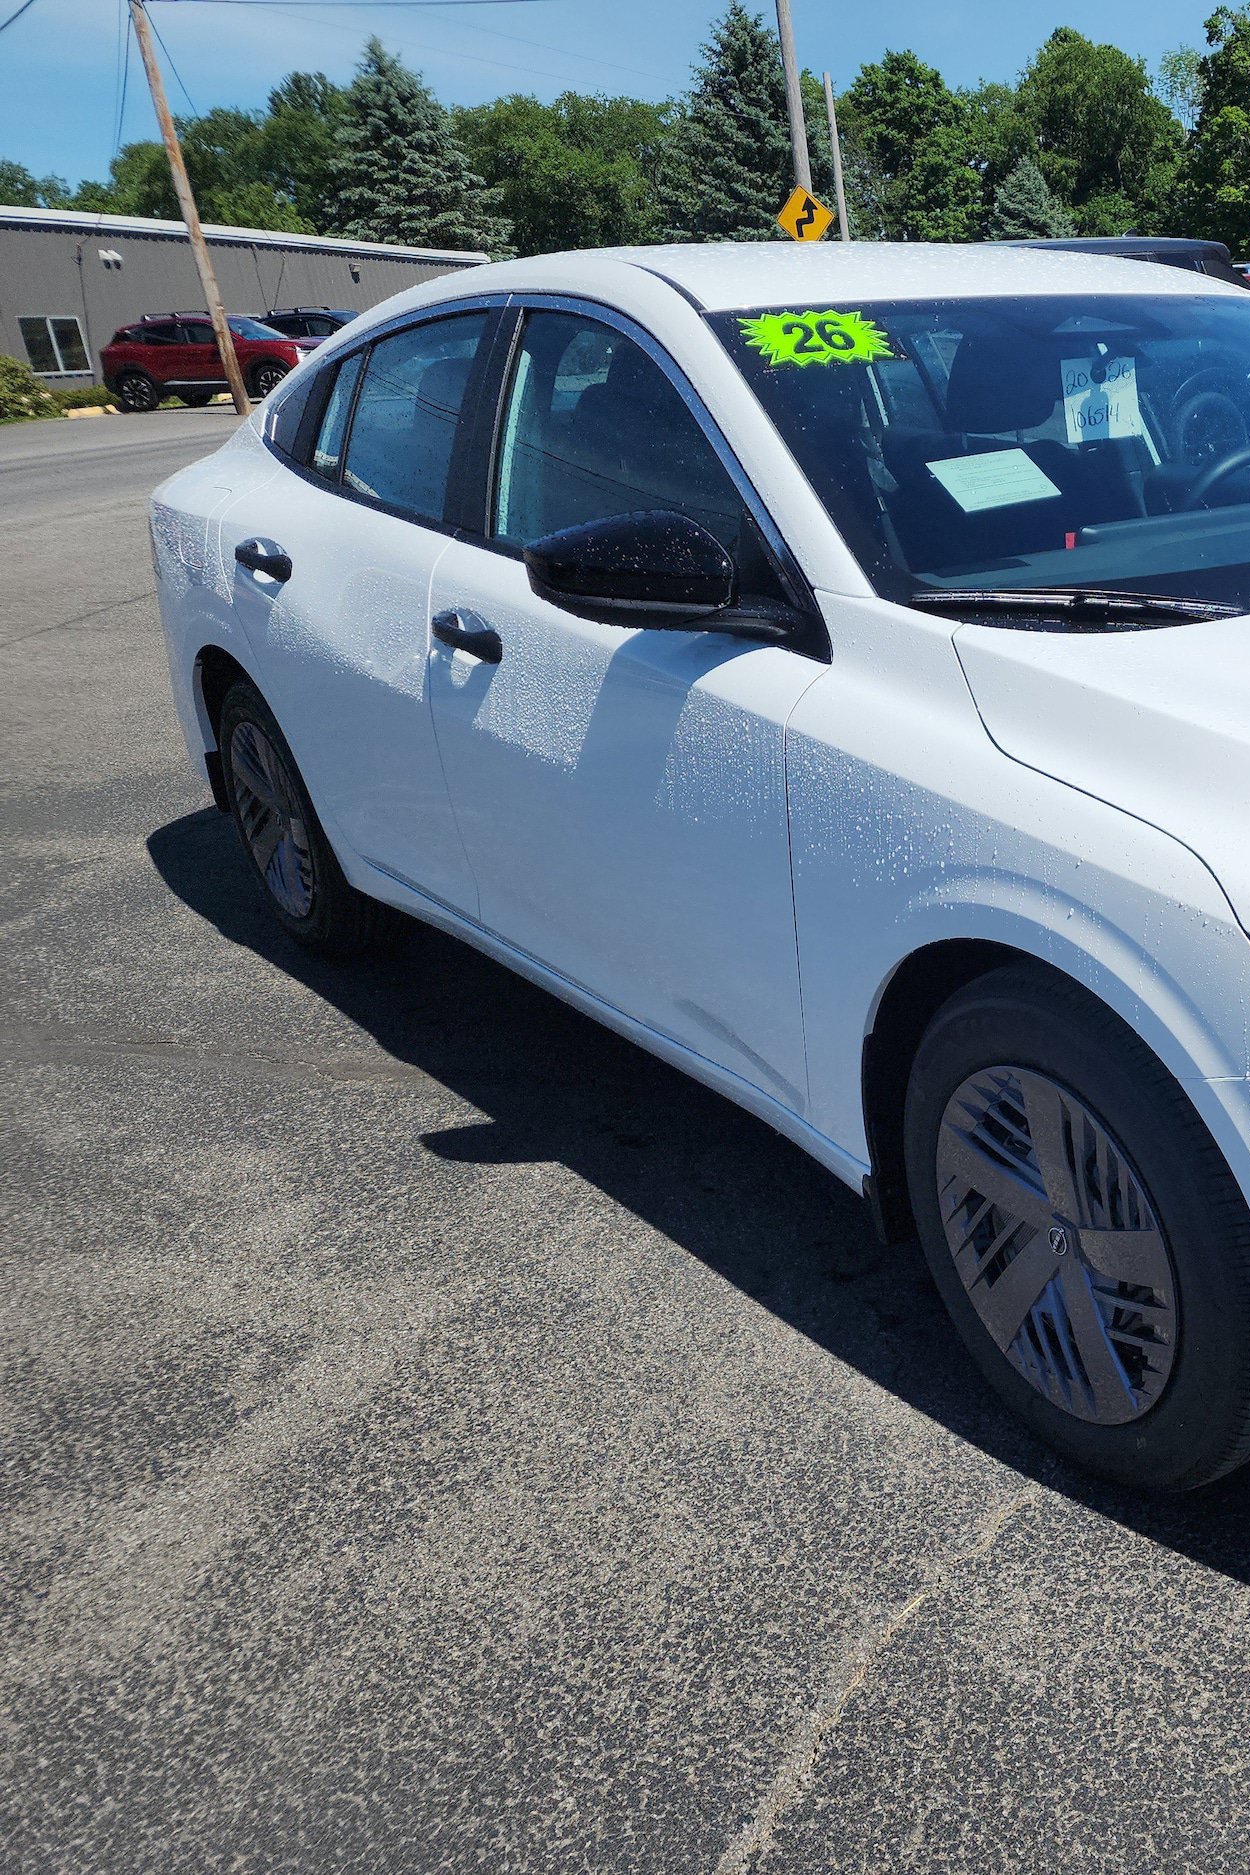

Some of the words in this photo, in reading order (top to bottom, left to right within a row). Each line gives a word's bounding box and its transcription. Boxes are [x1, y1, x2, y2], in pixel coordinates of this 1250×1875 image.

[782, 318, 856, 354] 26
[1066, 369, 1088, 395] 20
[1108, 361, 1132, 383] 26
[1071, 402, 1119, 432] 106514
